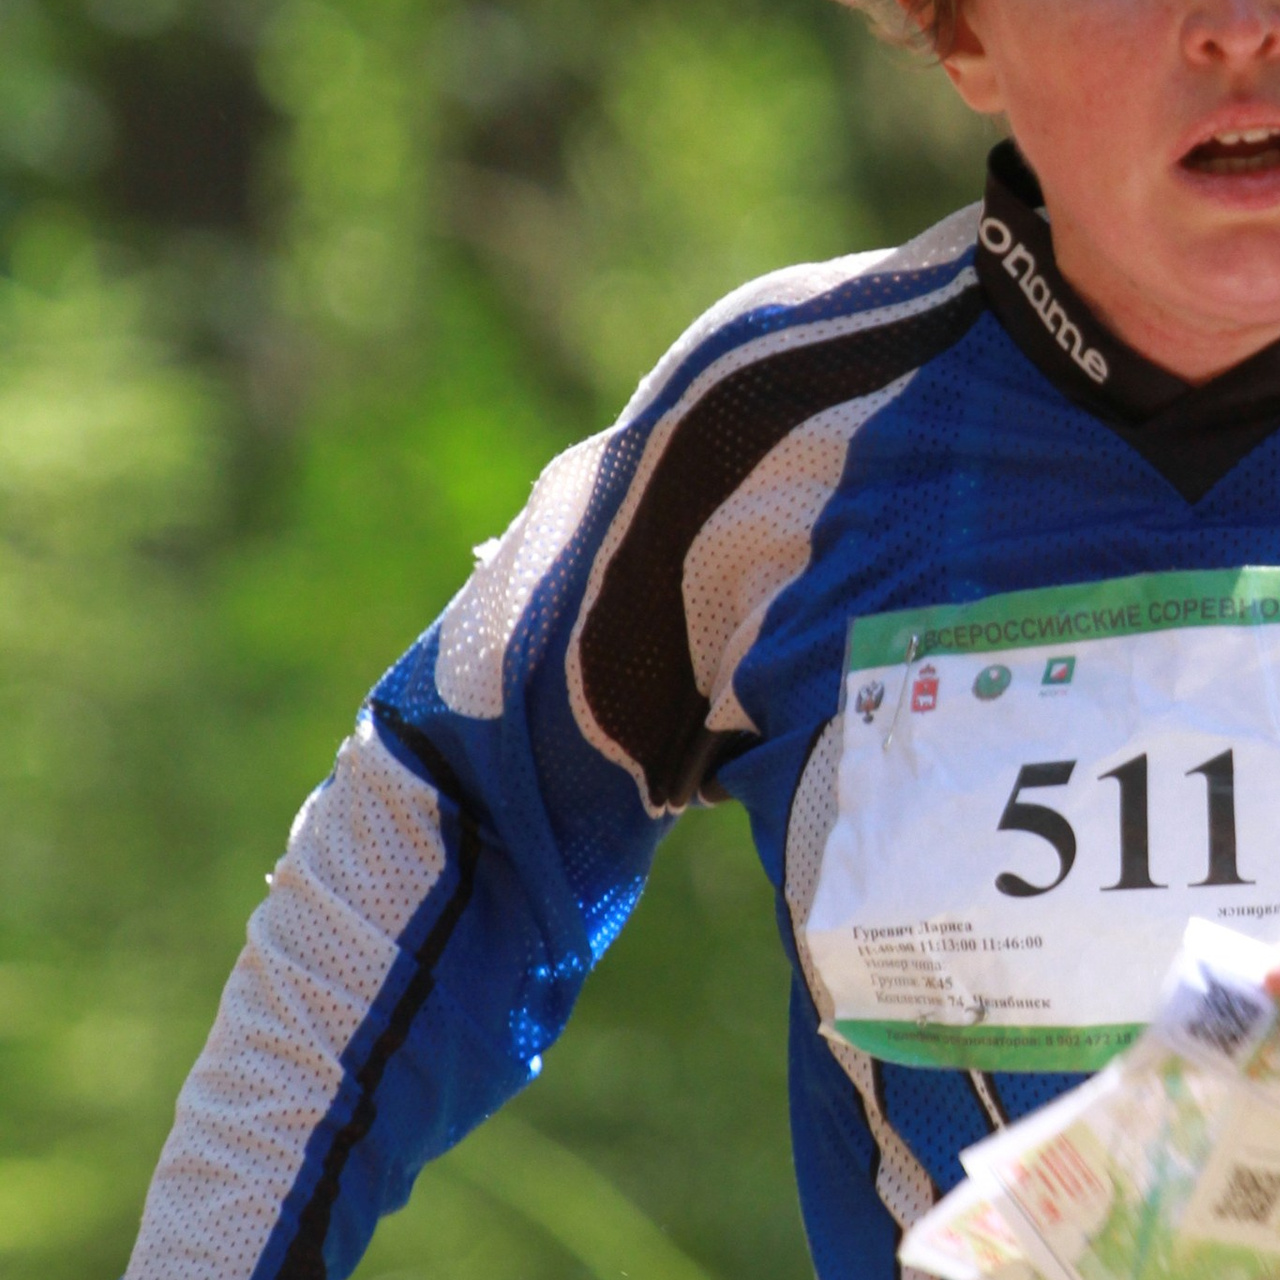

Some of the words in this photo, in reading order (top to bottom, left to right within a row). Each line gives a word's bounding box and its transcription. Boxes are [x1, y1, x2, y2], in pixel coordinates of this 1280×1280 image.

[923, 604, 1143, 653] ВСЕРОССИЙСКИЕ
[995, 748, 1256, 898] 511
[853, 926, 914, 942] Гуревич
[918, 921, 973, 934] Лариса
[920, 938, 977, 953] 11:13:00
[982, 935, 1043, 952] 11:46:00
